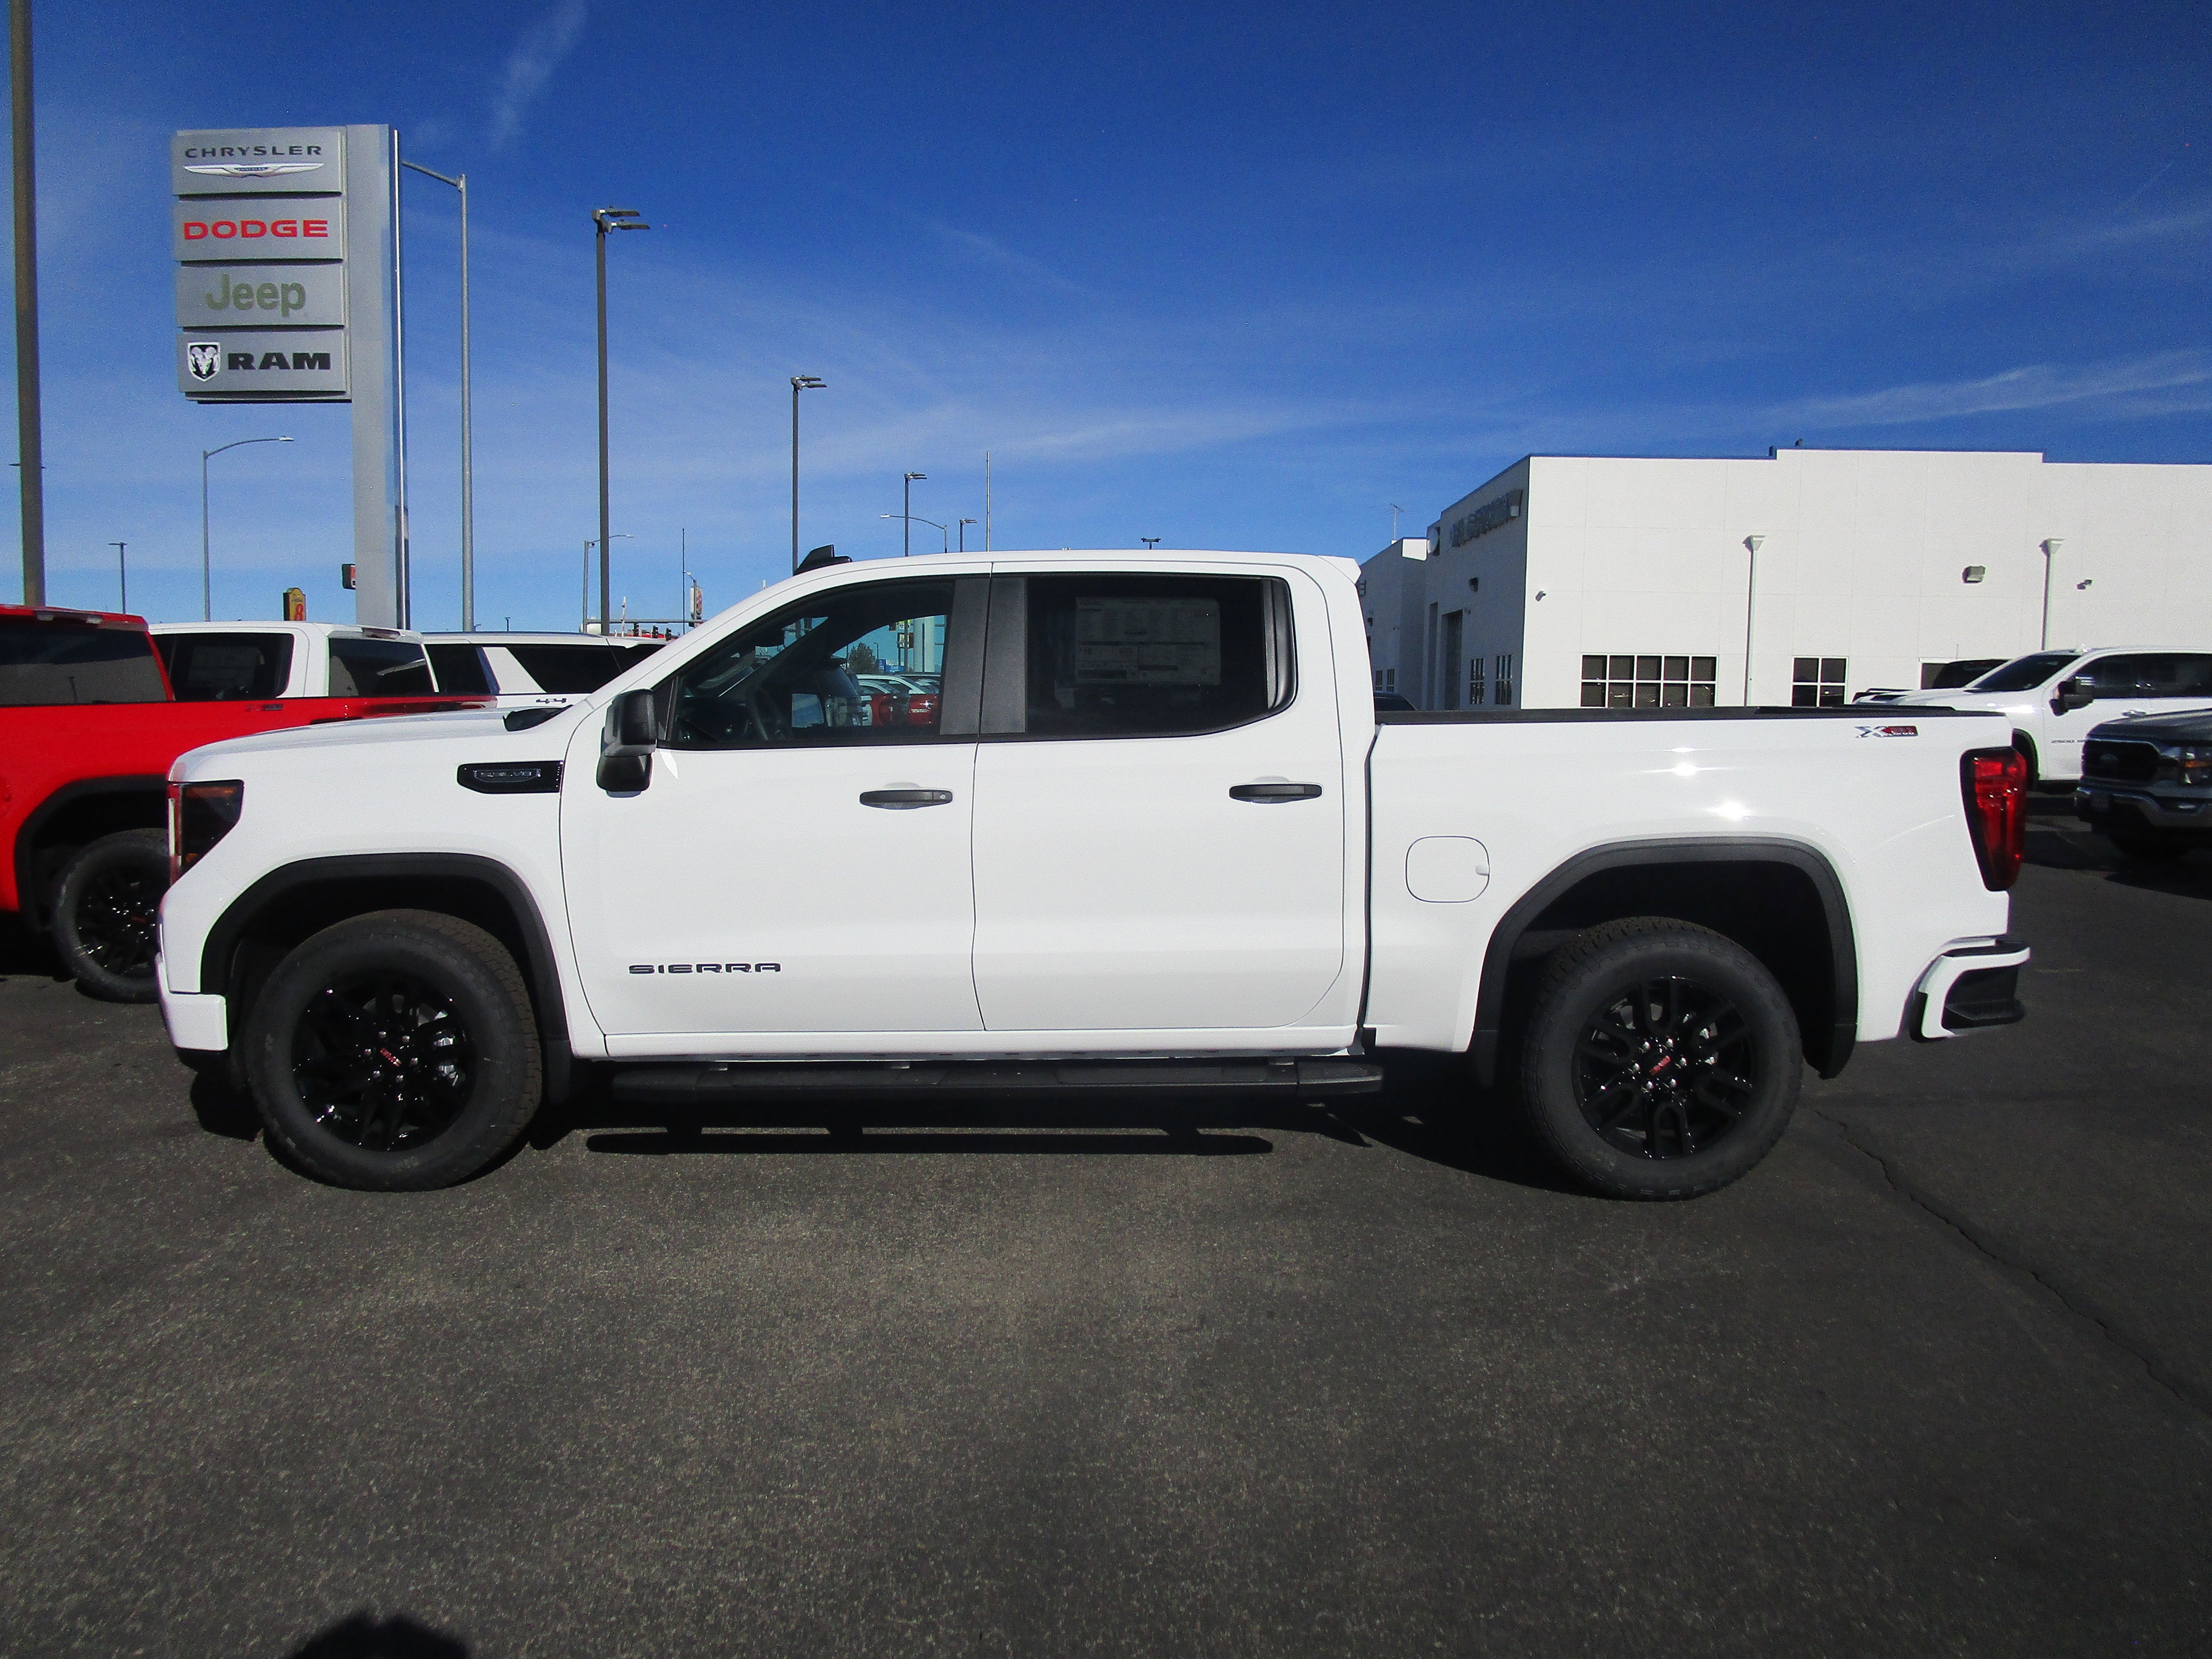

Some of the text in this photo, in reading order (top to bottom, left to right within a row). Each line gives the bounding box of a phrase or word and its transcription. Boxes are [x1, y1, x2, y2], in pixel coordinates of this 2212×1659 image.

[185, 146, 322, 158] CHRYSLER
[183, 219, 328, 240] DODGE
[204, 273, 307, 318] Jeep
[228, 352, 331, 370] RAM
[629, 963, 781, 974] SIERRA
